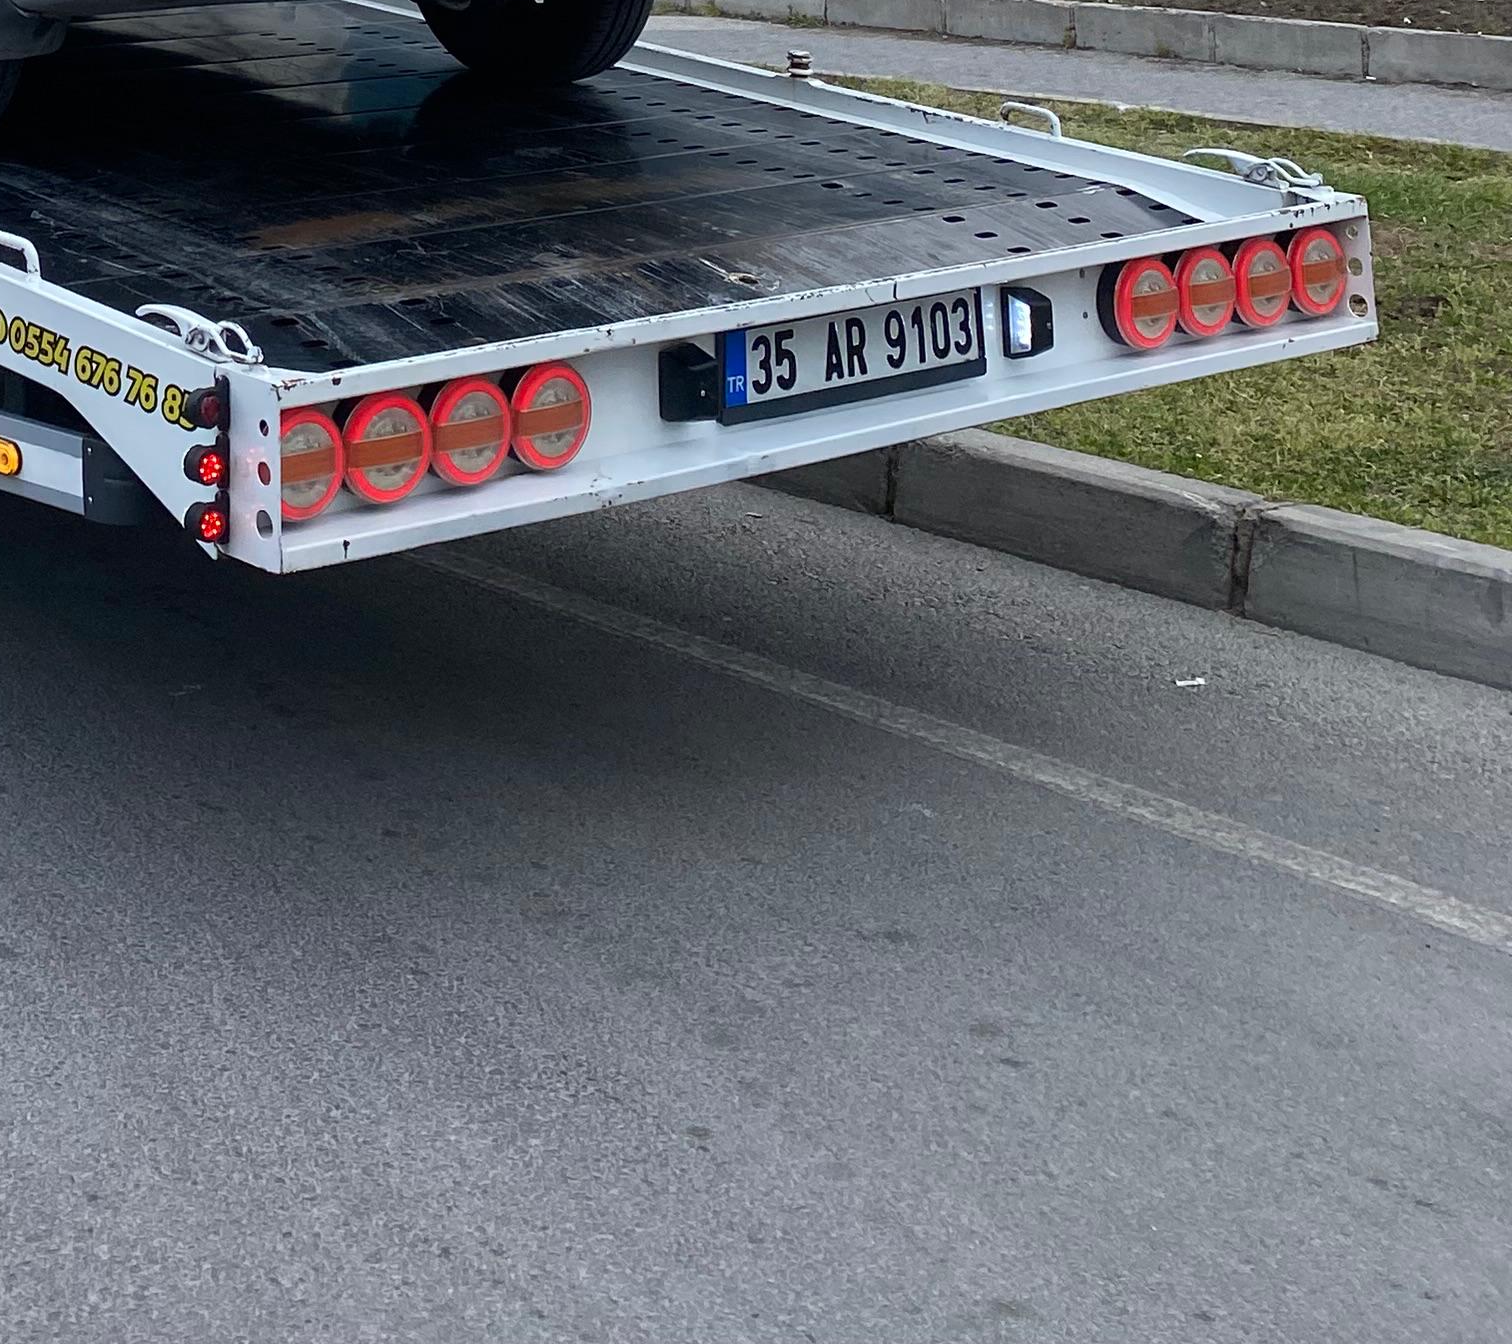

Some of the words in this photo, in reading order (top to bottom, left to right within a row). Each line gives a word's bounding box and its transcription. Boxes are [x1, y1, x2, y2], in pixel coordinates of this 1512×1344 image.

[8, 315, 72, 376] 0554
[74, 344, 122, 397] 676
[124, 364, 158, 414] 76
[727, 375, 745, 393] TR
[751, 329, 798, 394] 35
[825, 316, 868, 383] AR
[885, 296, 974, 370] 9103
